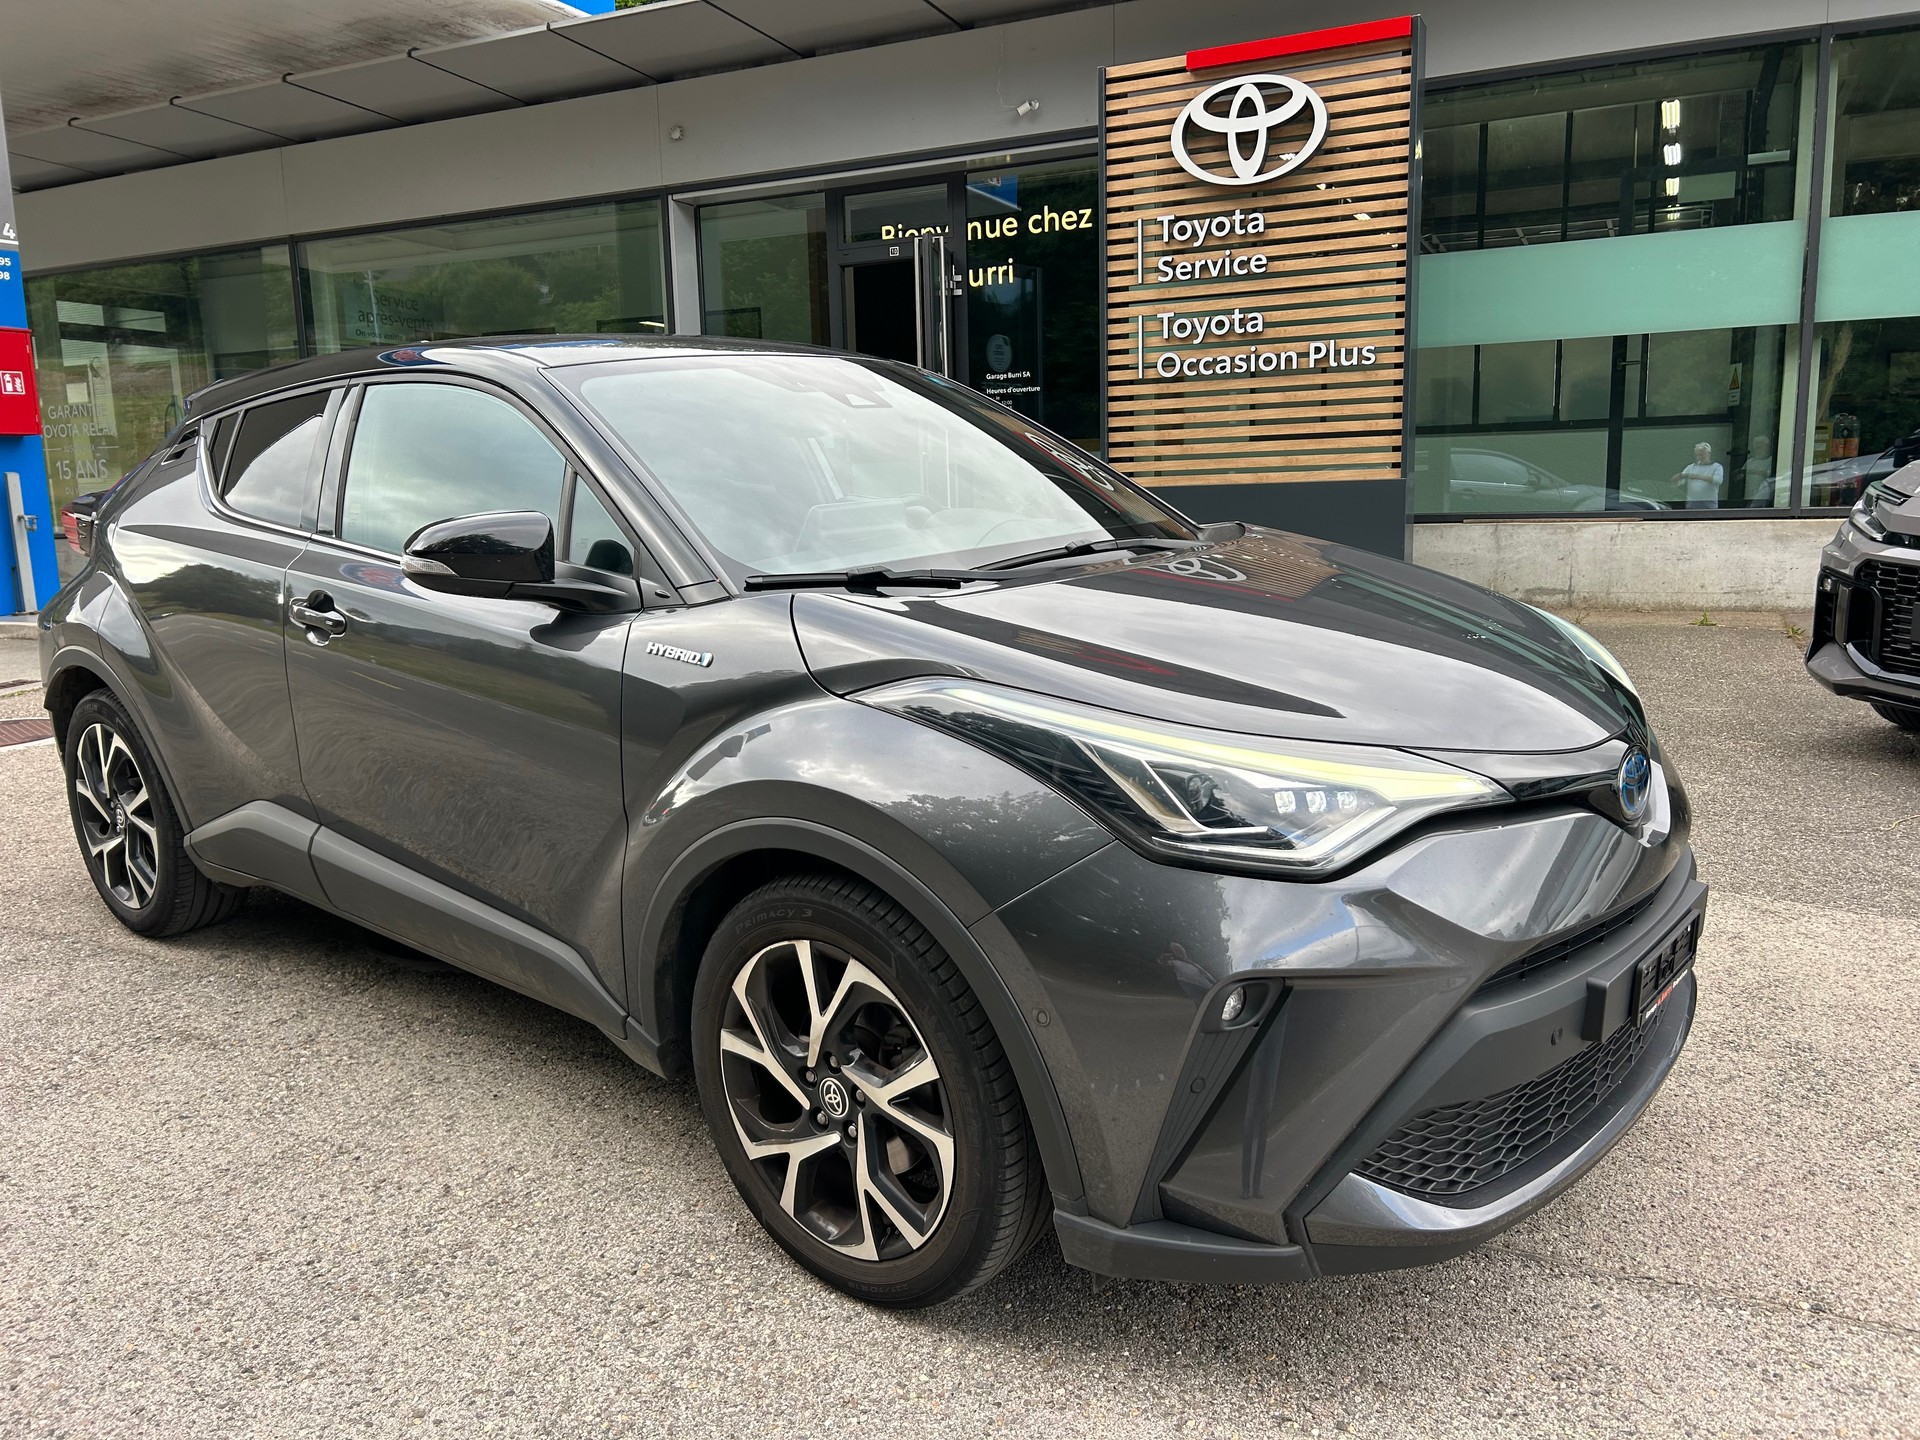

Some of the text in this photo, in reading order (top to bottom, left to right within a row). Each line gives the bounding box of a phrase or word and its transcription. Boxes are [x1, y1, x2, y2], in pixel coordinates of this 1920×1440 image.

[3, 222, 16, 240] 4
[1028, 205, 1093, 233] chez
[1156, 209, 1266, 247] Toyota
[968, 257, 1014, 288] urri
[1157, 249, 1268, 283] Service
[1156, 308, 1265, 345] Toyota
[1157, 339, 1377, 379] Occasion Plus
[43, 422, 119, 439] OYOTA RELAX
[56, 459, 108, 480] 15 ANS
[645, 641, 702, 665] HYBRID
[801, 908, 813, 918] 3
